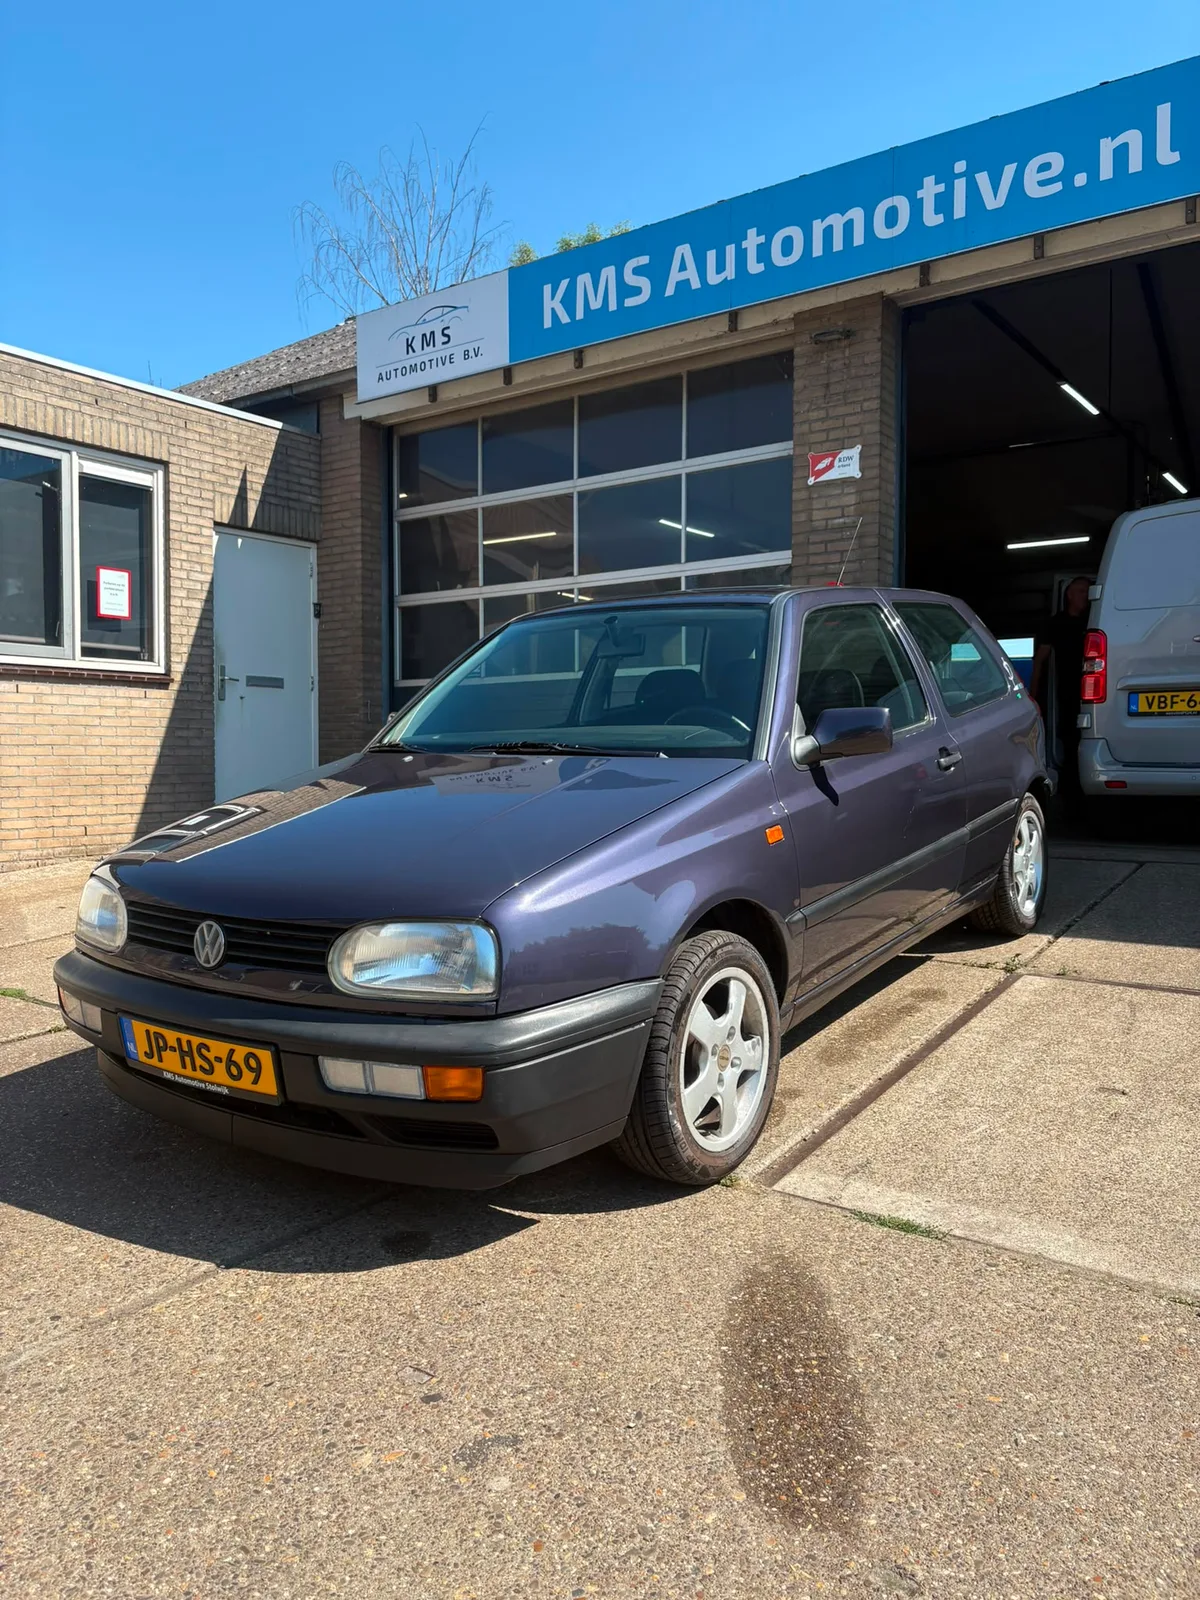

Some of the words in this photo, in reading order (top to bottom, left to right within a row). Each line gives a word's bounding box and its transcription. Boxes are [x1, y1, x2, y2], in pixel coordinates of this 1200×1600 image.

[542, 254, 652, 330] KMS
[664, 102, 1182, 298] Automotive.nl
[405, 326, 452, 355] KMS
[376, 352, 455, 384] AUTOMOTIVE
[463, 346, 484, 361] B.V.
[838, 455, 854, 463] RDW
[1145, 693, 1200, 710] VBF-6
[127, 1042, 137, 1054] NL
[144, 1029, 262, 1085] JP-HS-69
[162, 1070, 175, 1081] KMS
[174, 1075, 206, 1088] Automotive
[206, 1082, 230, 1095] Stolwijk
